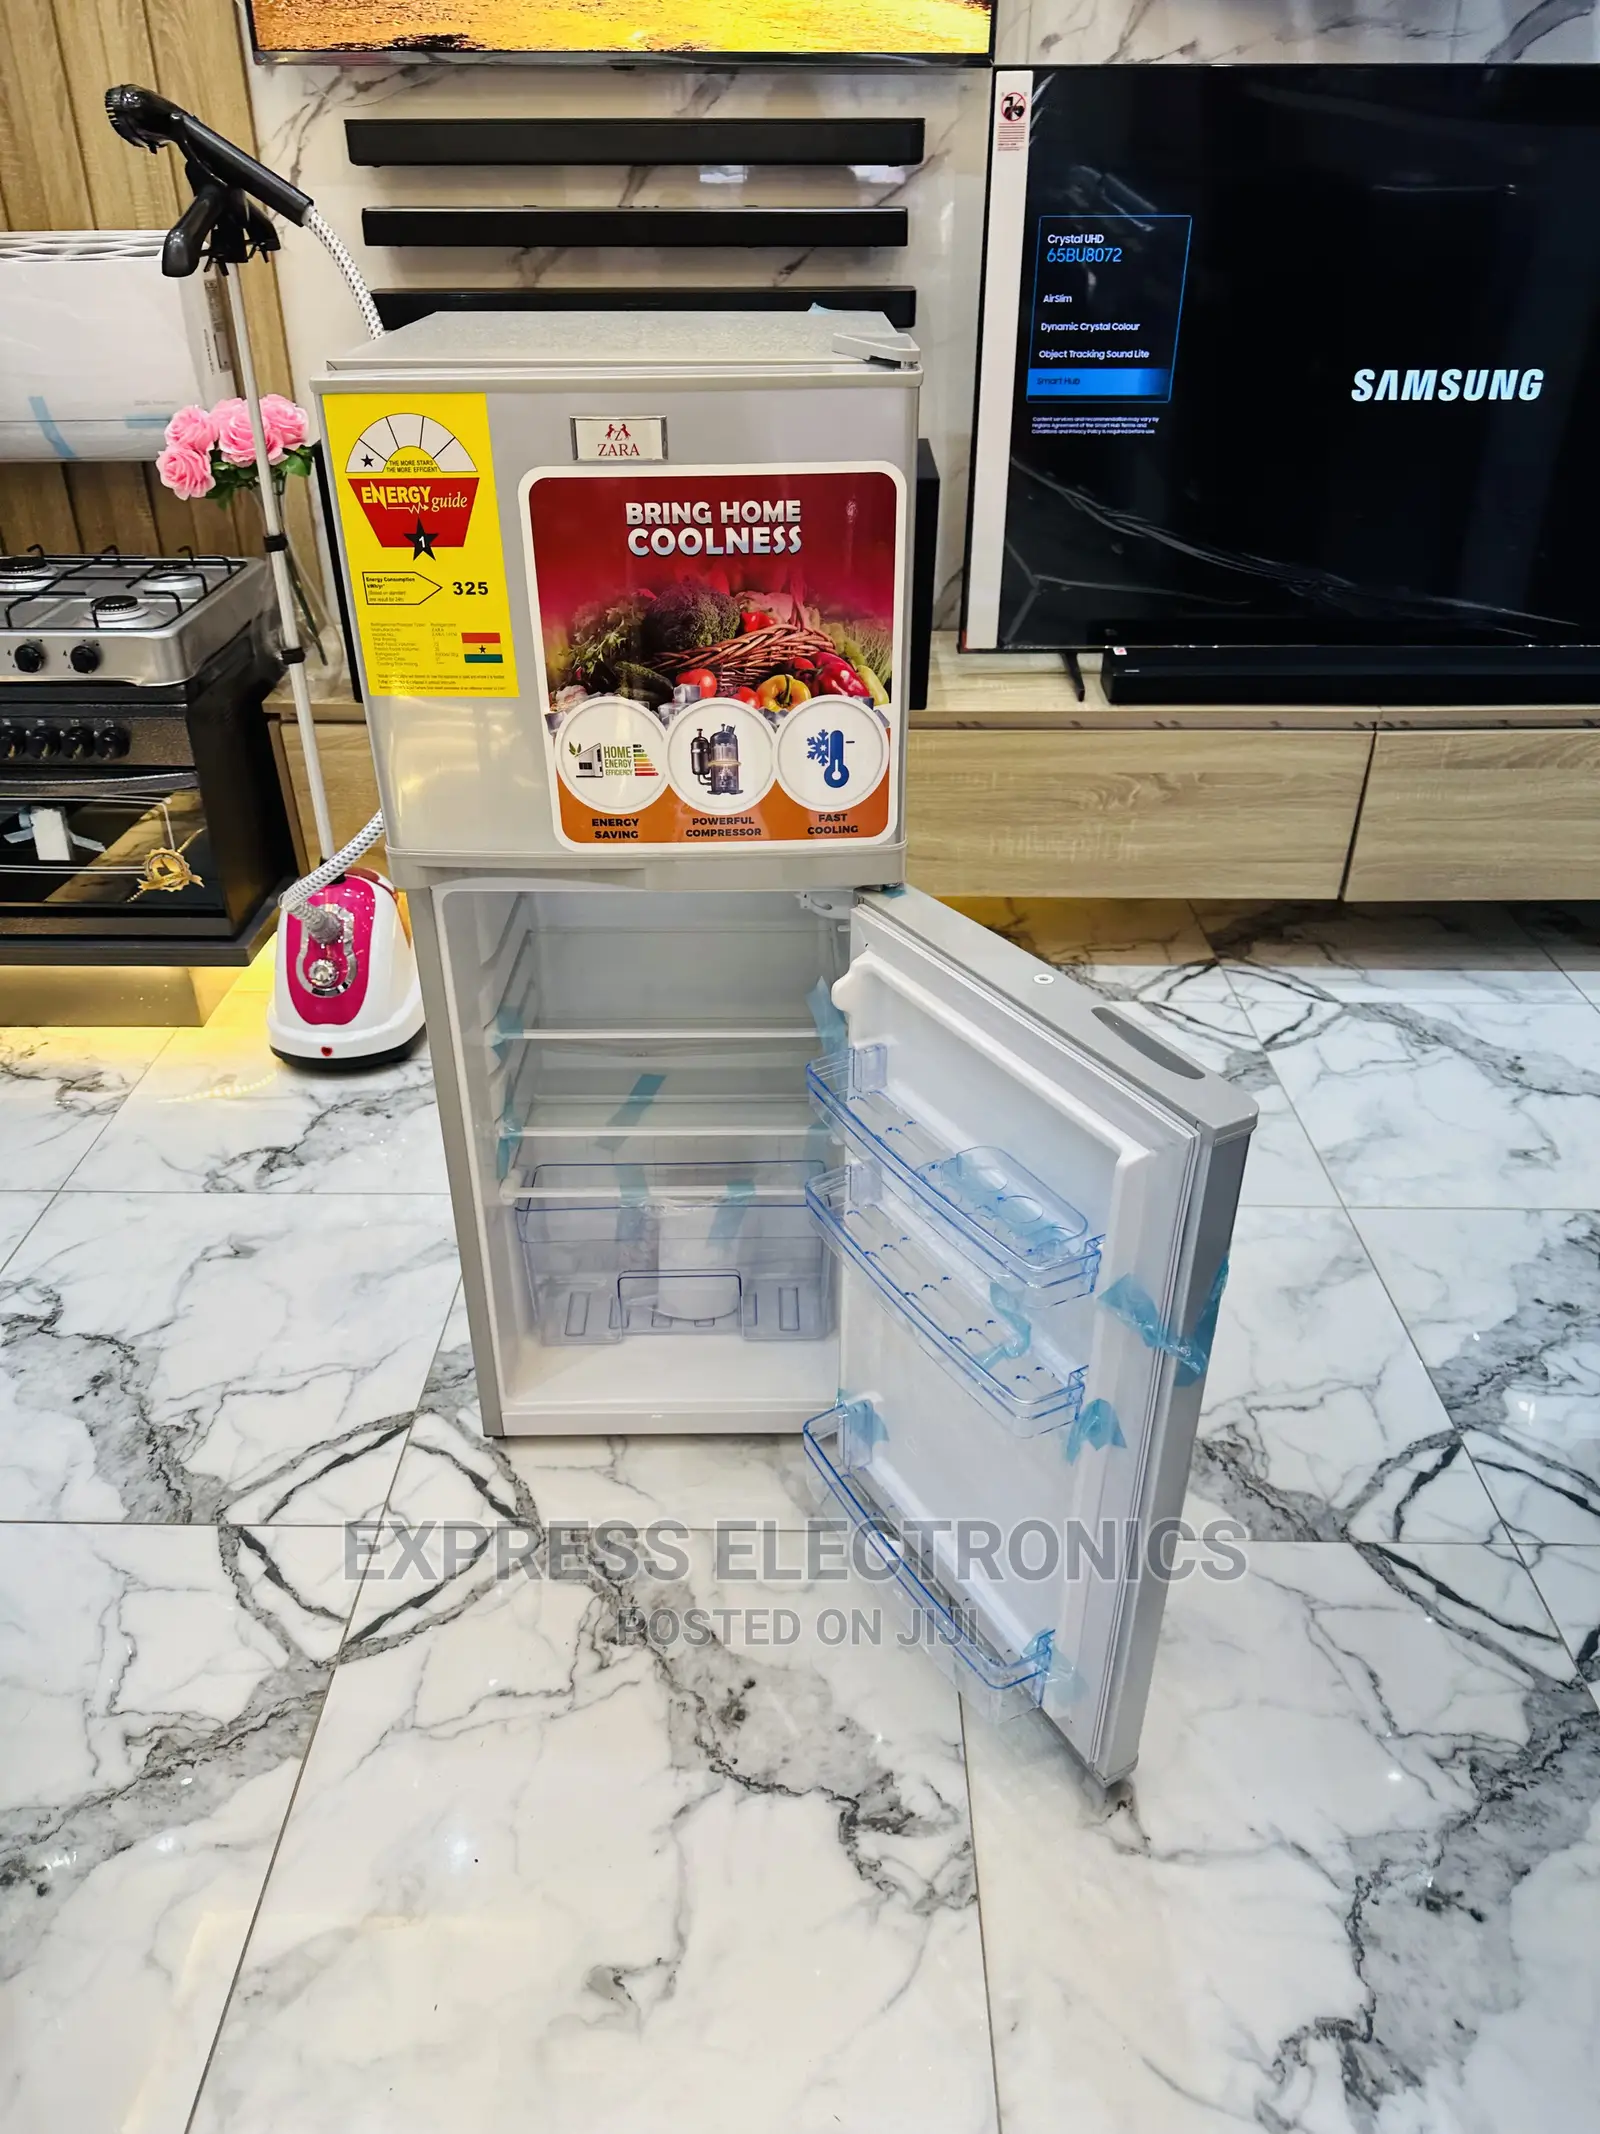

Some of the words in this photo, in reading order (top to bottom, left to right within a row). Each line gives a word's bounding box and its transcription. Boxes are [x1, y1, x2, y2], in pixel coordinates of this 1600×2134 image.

[1047, 234, 1083, 246] Crystal
[1084, 234, 1104, 244] UHD
[1046, 247, 1122, 263] 65BU8072
[1043, 294, 1072, 303] AirSlim
[1041, 322, 1079, 333] Dynamic
[1079, 322, 1111, 333] Crystal
[1111, 322, 1140, 331] Colour
[1039, 350, 1068, 361] Object
[1069, 350, 1105, 360] Tracking
[1106, 350, 1133, 359] Sound
[1134, 350, 1150, 359] Lite
[1037, 376, 1062, 385] Smart
[1064, 376, 1080, 385] Hub
[1351, 368, 1544, 402] SAMSUNG
[597, 443, 640, 457] ZARA
[361, 482, 431, 509] ENERGY
[431, 492, 468, 513] guide
[626, 501, 711, 526] BRING
[720, 500, 802, 525] HOME
[627, 525, 802, 556] COOLNESS
[452, 581, 489, 596] 325
[603, 745, 632, 759] HOME
[604, 758, 632, 769] ENERGY
[591, 817, 640, 828] ENERGY
[691, 816, 755, 827] POWERFUL
[818, 813, 848, 823] FAST
[594, 830, 639, 840] SAVING
[686, 828, 762, 838] COMPRESSOR
[807, 824, 859, 836] COOLING
